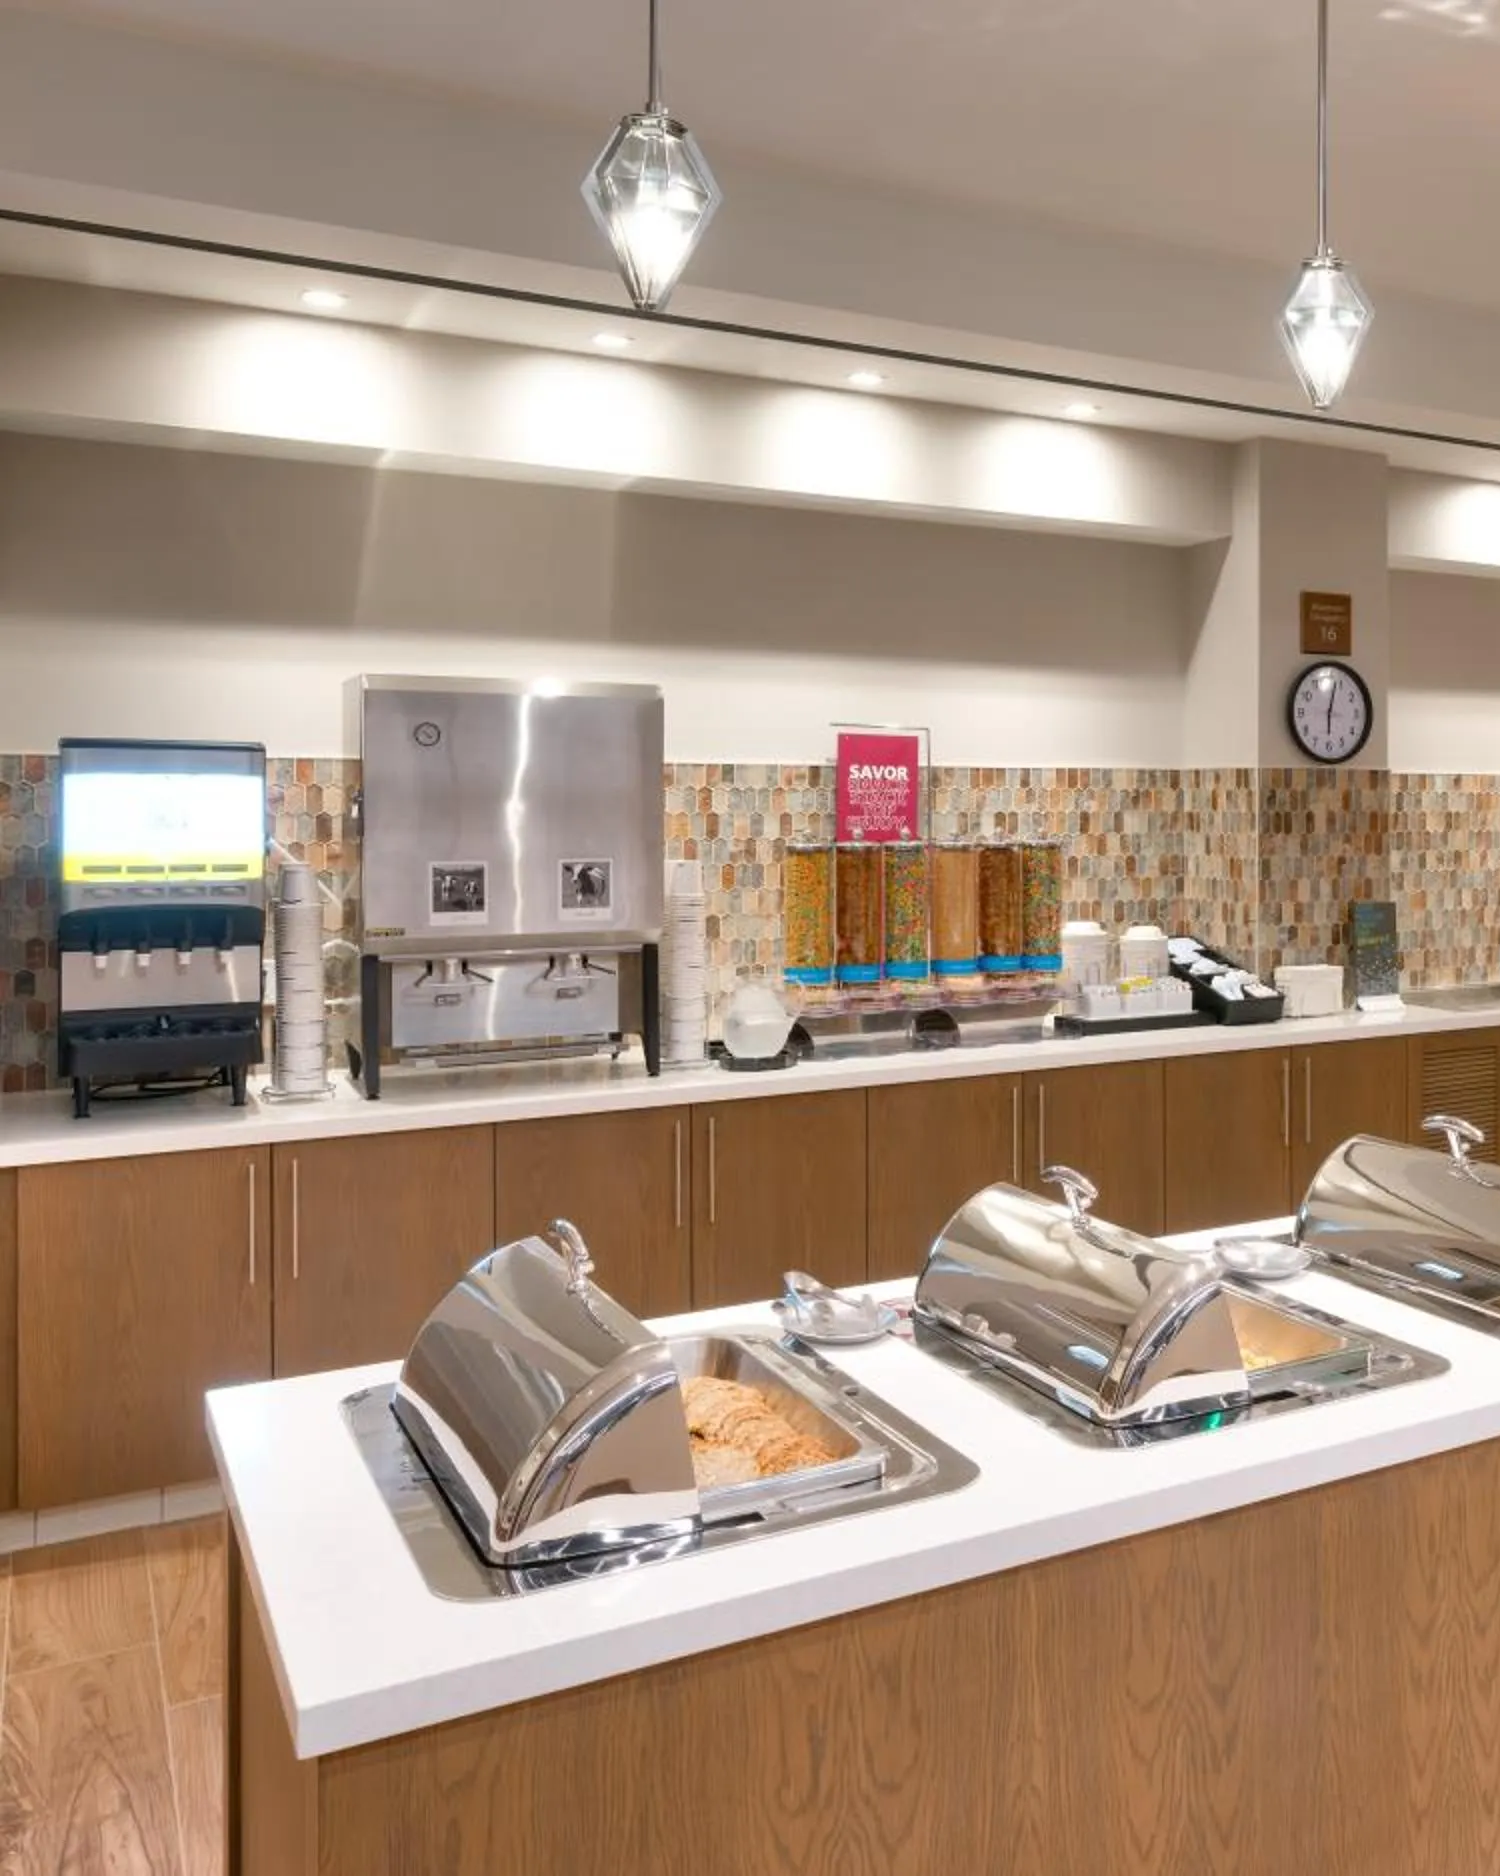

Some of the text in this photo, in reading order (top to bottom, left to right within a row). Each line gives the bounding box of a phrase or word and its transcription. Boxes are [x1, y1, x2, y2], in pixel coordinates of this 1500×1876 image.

[1320, 625, 1338, 643] 16
[1325, 739, 1333, 753] 6
[848, 764, 908, 781] SAVOR
